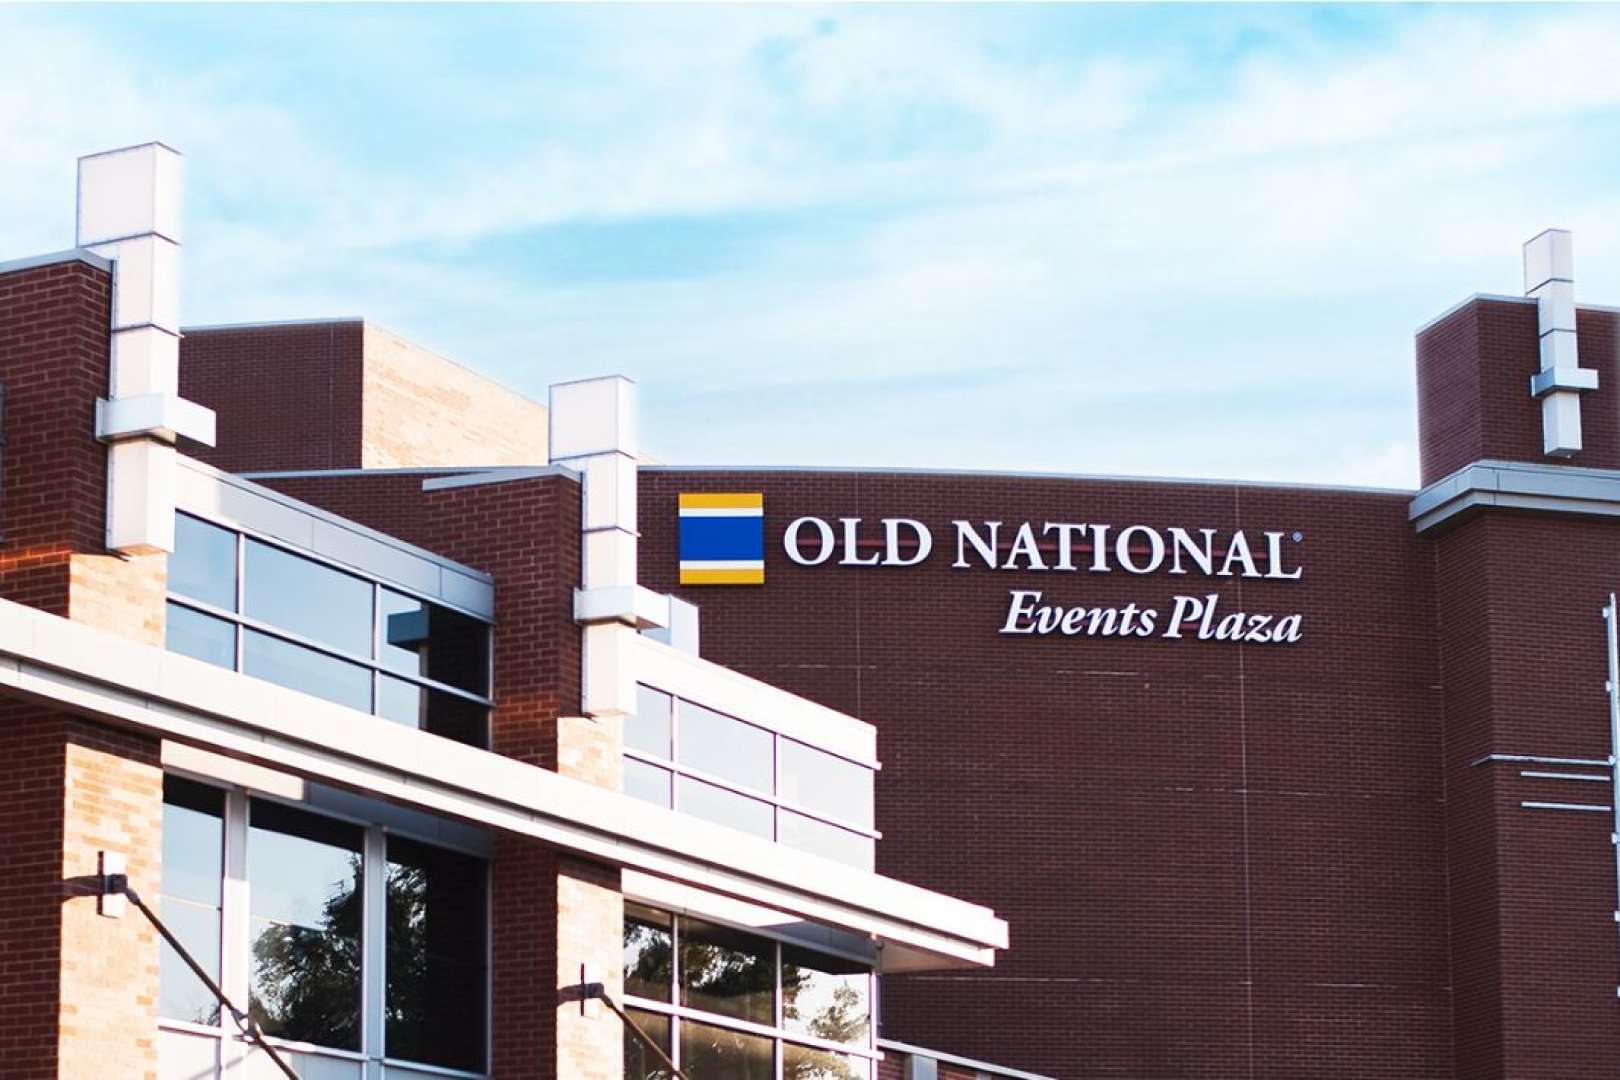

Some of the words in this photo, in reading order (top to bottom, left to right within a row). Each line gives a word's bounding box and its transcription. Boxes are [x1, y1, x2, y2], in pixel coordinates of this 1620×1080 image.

[783, 516, 932, 567] OLD
[951, 520, 1304, 580] NATIONAL
[999, 589, 1157, 638] Events
[1162, 594, 1304, 644] Plaza
